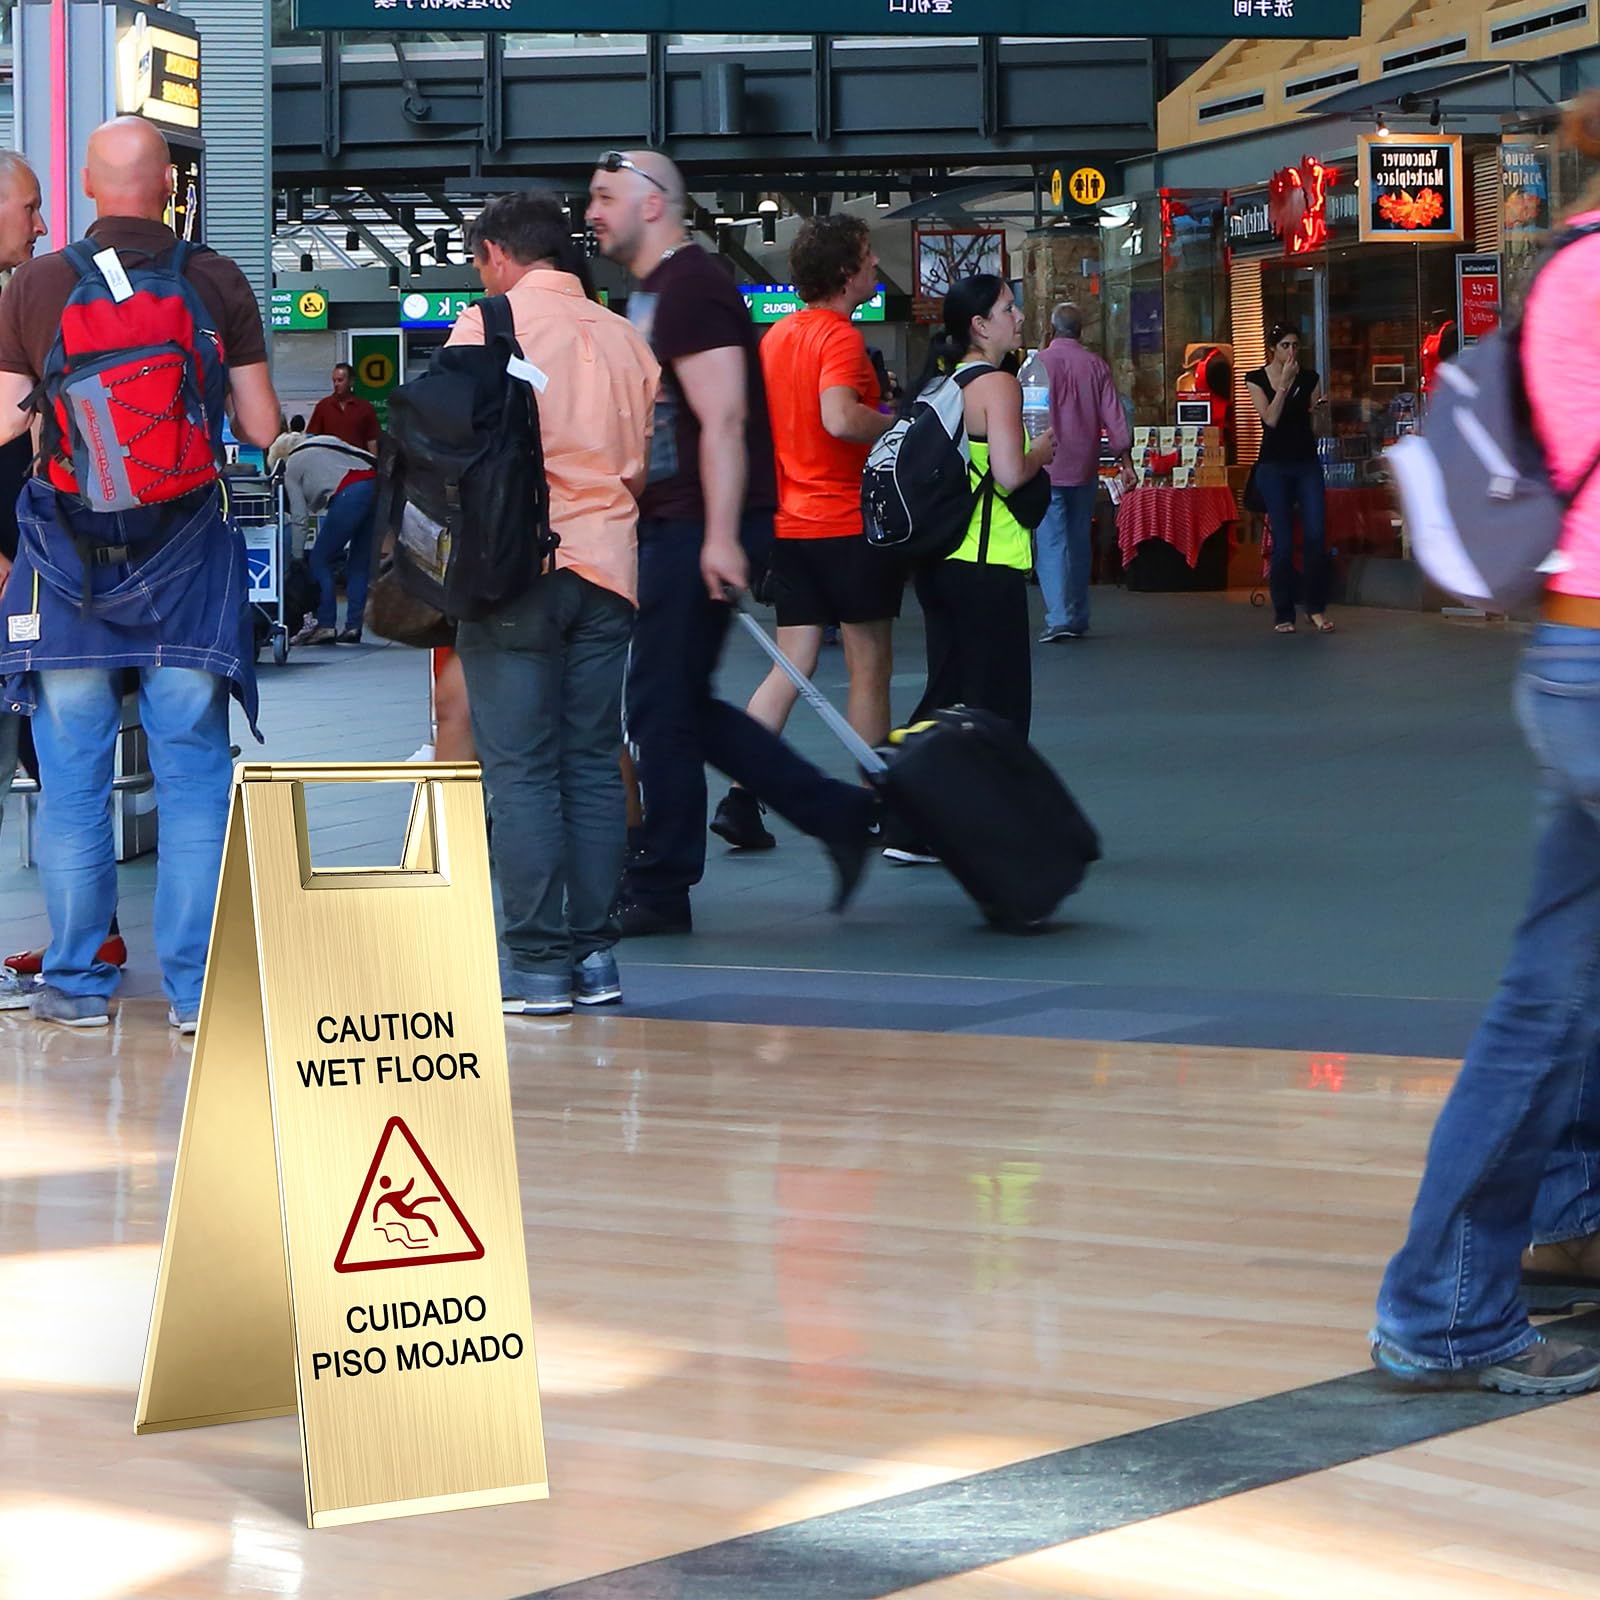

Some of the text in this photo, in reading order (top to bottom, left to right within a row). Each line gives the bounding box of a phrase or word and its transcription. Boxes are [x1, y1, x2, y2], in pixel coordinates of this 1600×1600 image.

[316, 1011, 455, 1044] CAUTION
[296, 1052, 481, 1088] WET FLOOR
[346, 1294, 487, 1334] CUIDADO
[312, 1332, 524, 1380] PISO MOJADO
